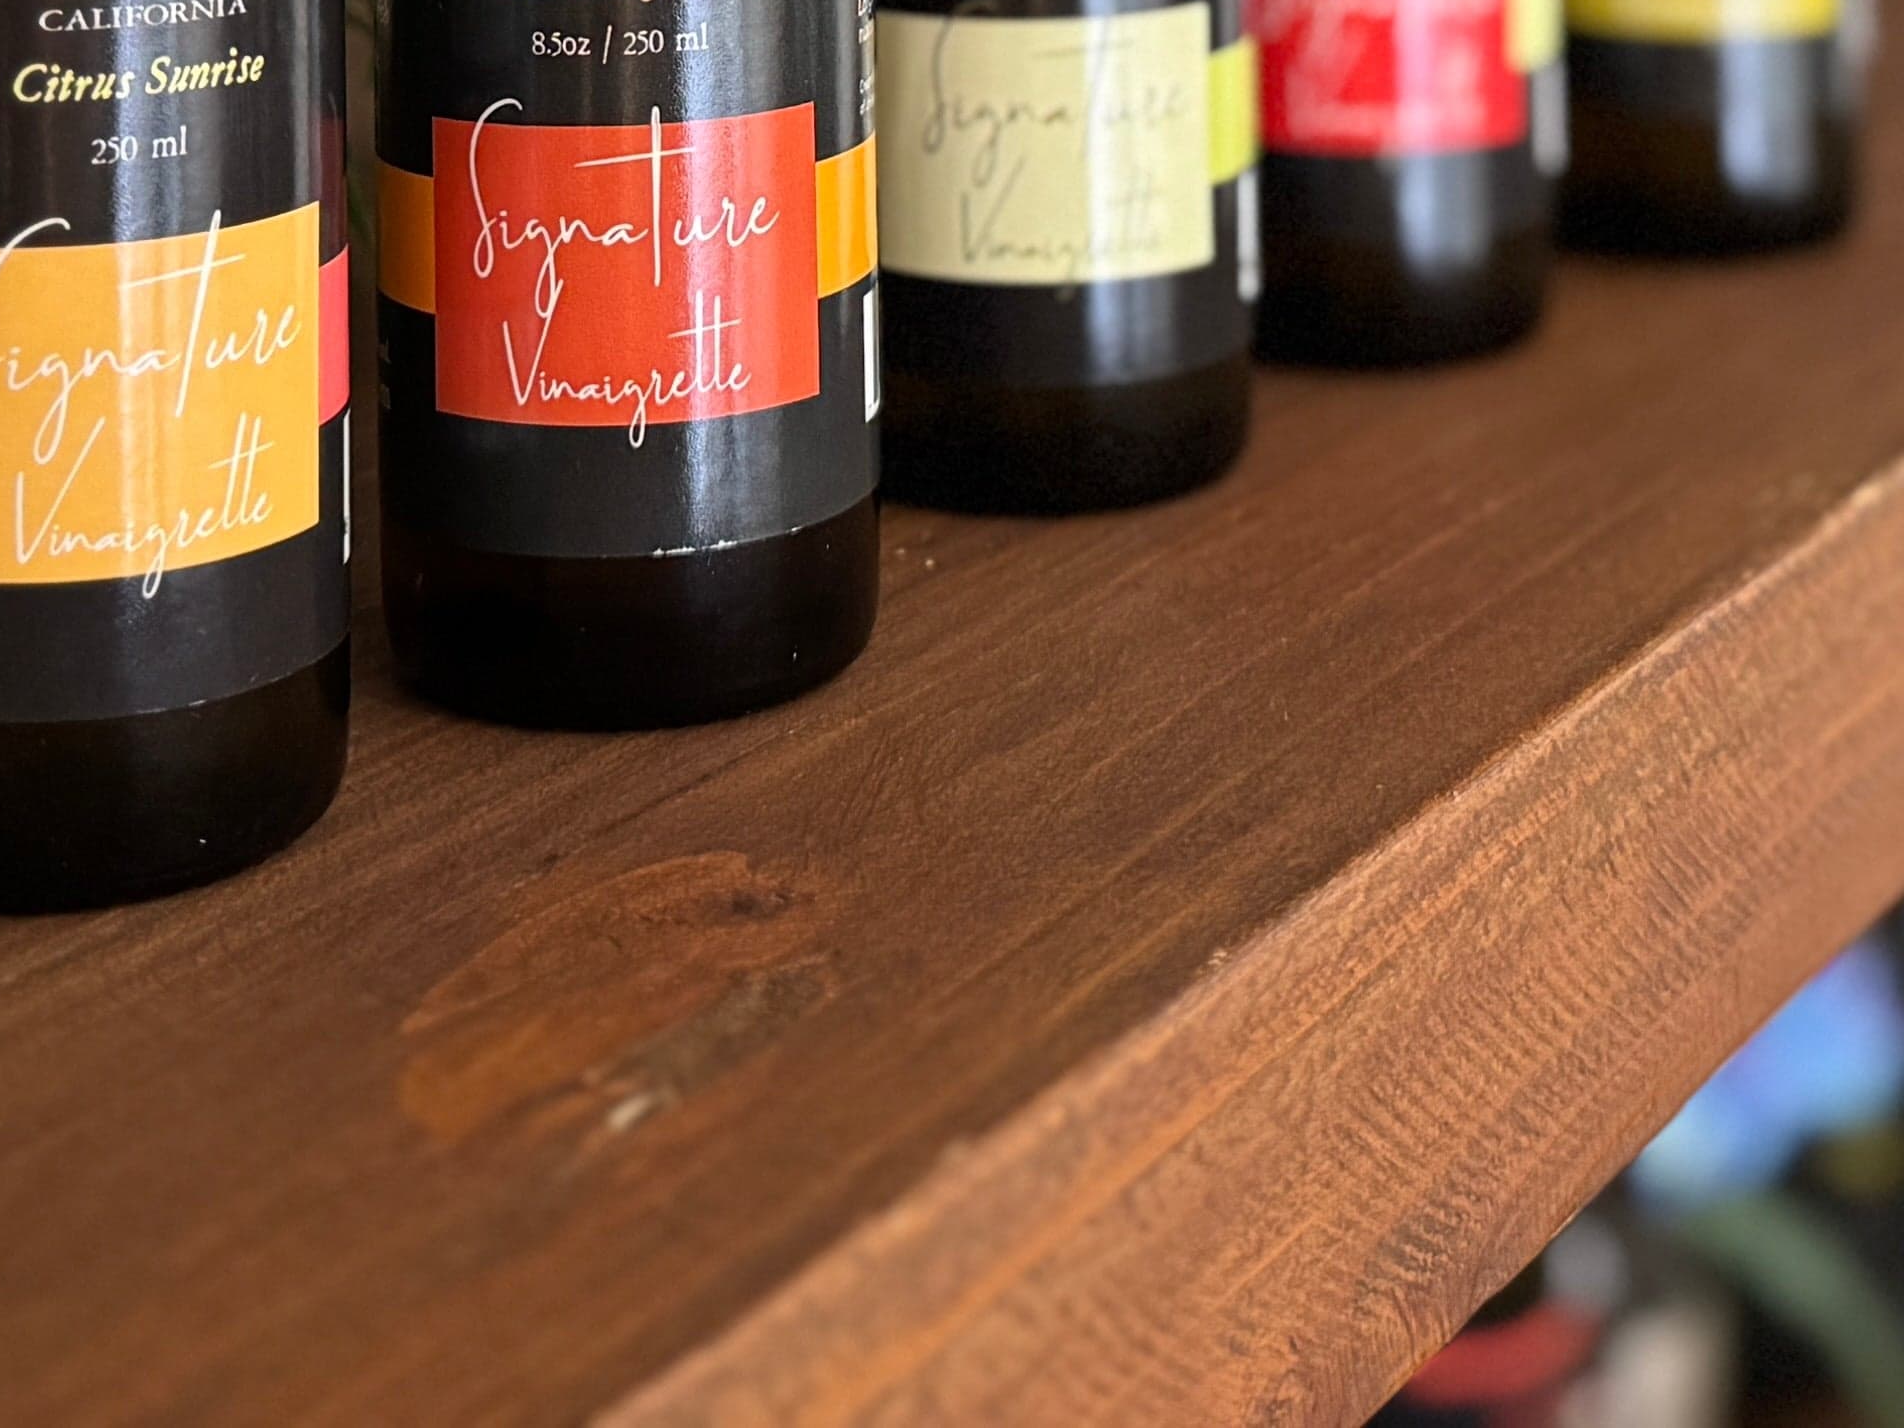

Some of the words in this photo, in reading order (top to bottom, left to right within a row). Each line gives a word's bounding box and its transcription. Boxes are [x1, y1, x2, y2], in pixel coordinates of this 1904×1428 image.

[13, 63, 136, 103] Citrus
[145, 47, 265, 95] Sunrise
[531, 31, 592, 57] 8.5oz
[602, 24, 613, 65] /
[623, 29, 664, 56] 250
[675, 22, 709, 52] ml
[91, 135, 138, 165] 250
[152, 125, 188, 159] ml
[468, 97, 780, 318] Signature
[503, 279, 752, 448] Vinaigrette
[14, 412, 275, 599] Vinaigrette
